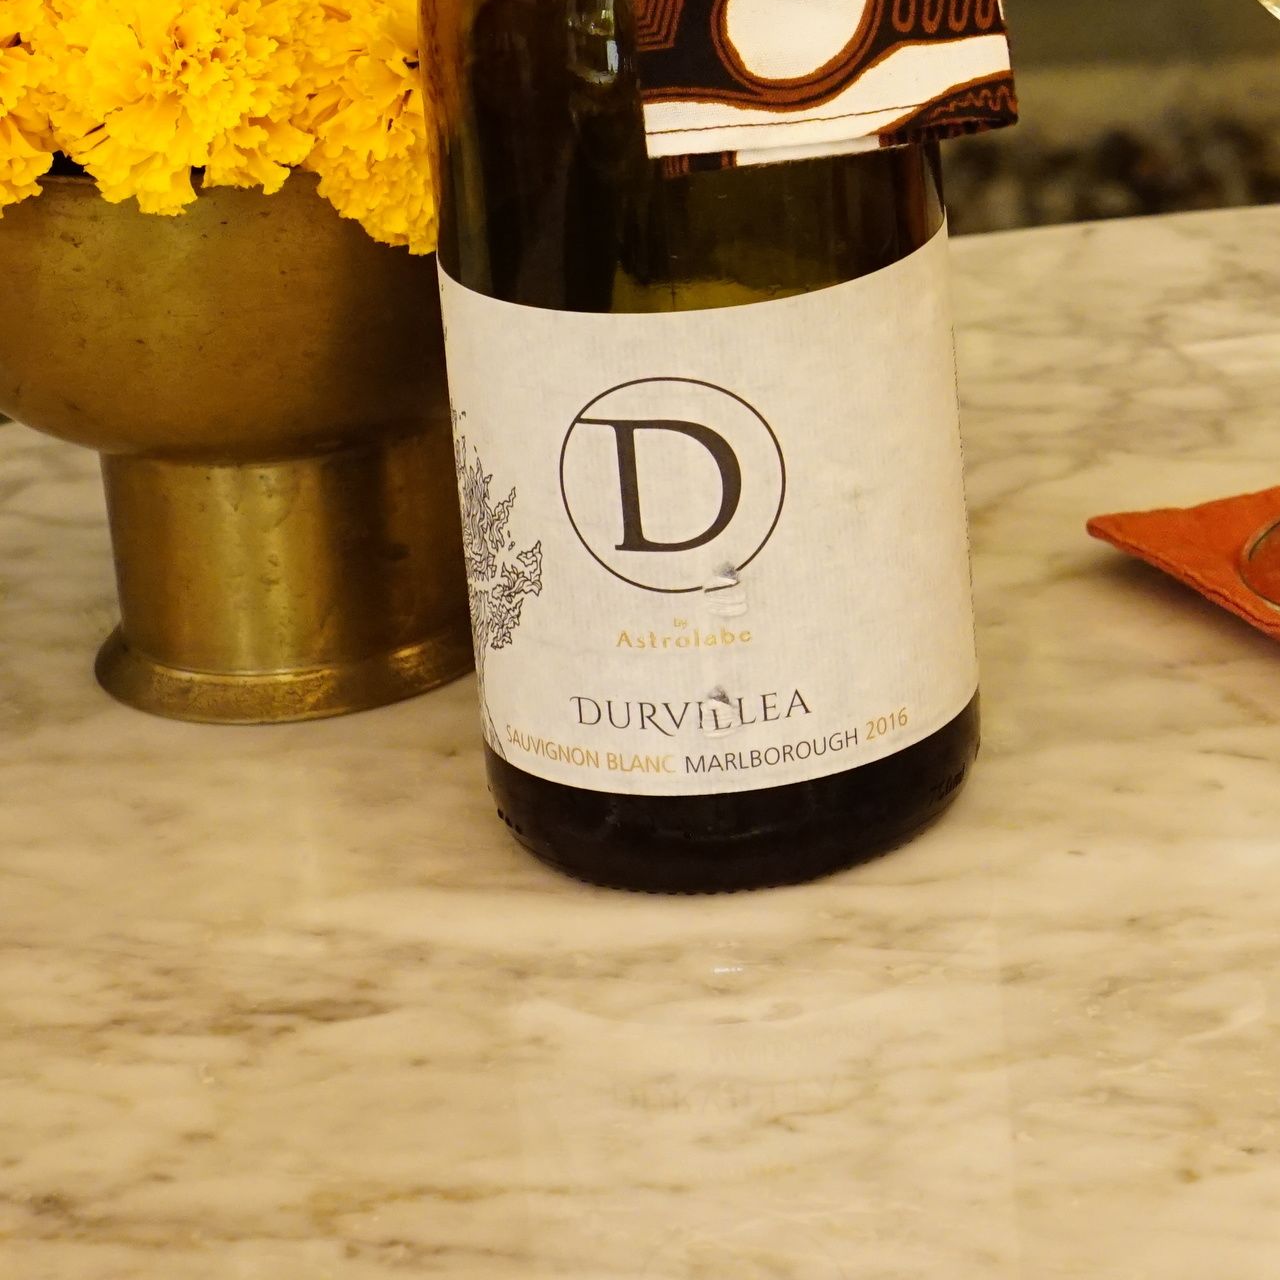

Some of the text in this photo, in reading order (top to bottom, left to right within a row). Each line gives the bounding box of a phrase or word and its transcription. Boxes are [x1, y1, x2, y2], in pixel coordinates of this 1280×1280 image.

[576, 418, 742, 552] D
[615, 626, 753, 649] Astrolabe
[506, 706, 909, 774] SAUVIGNON BLANC MARLBOROUGH 2016
[569, 688, 812, 737] DURVILLEA
